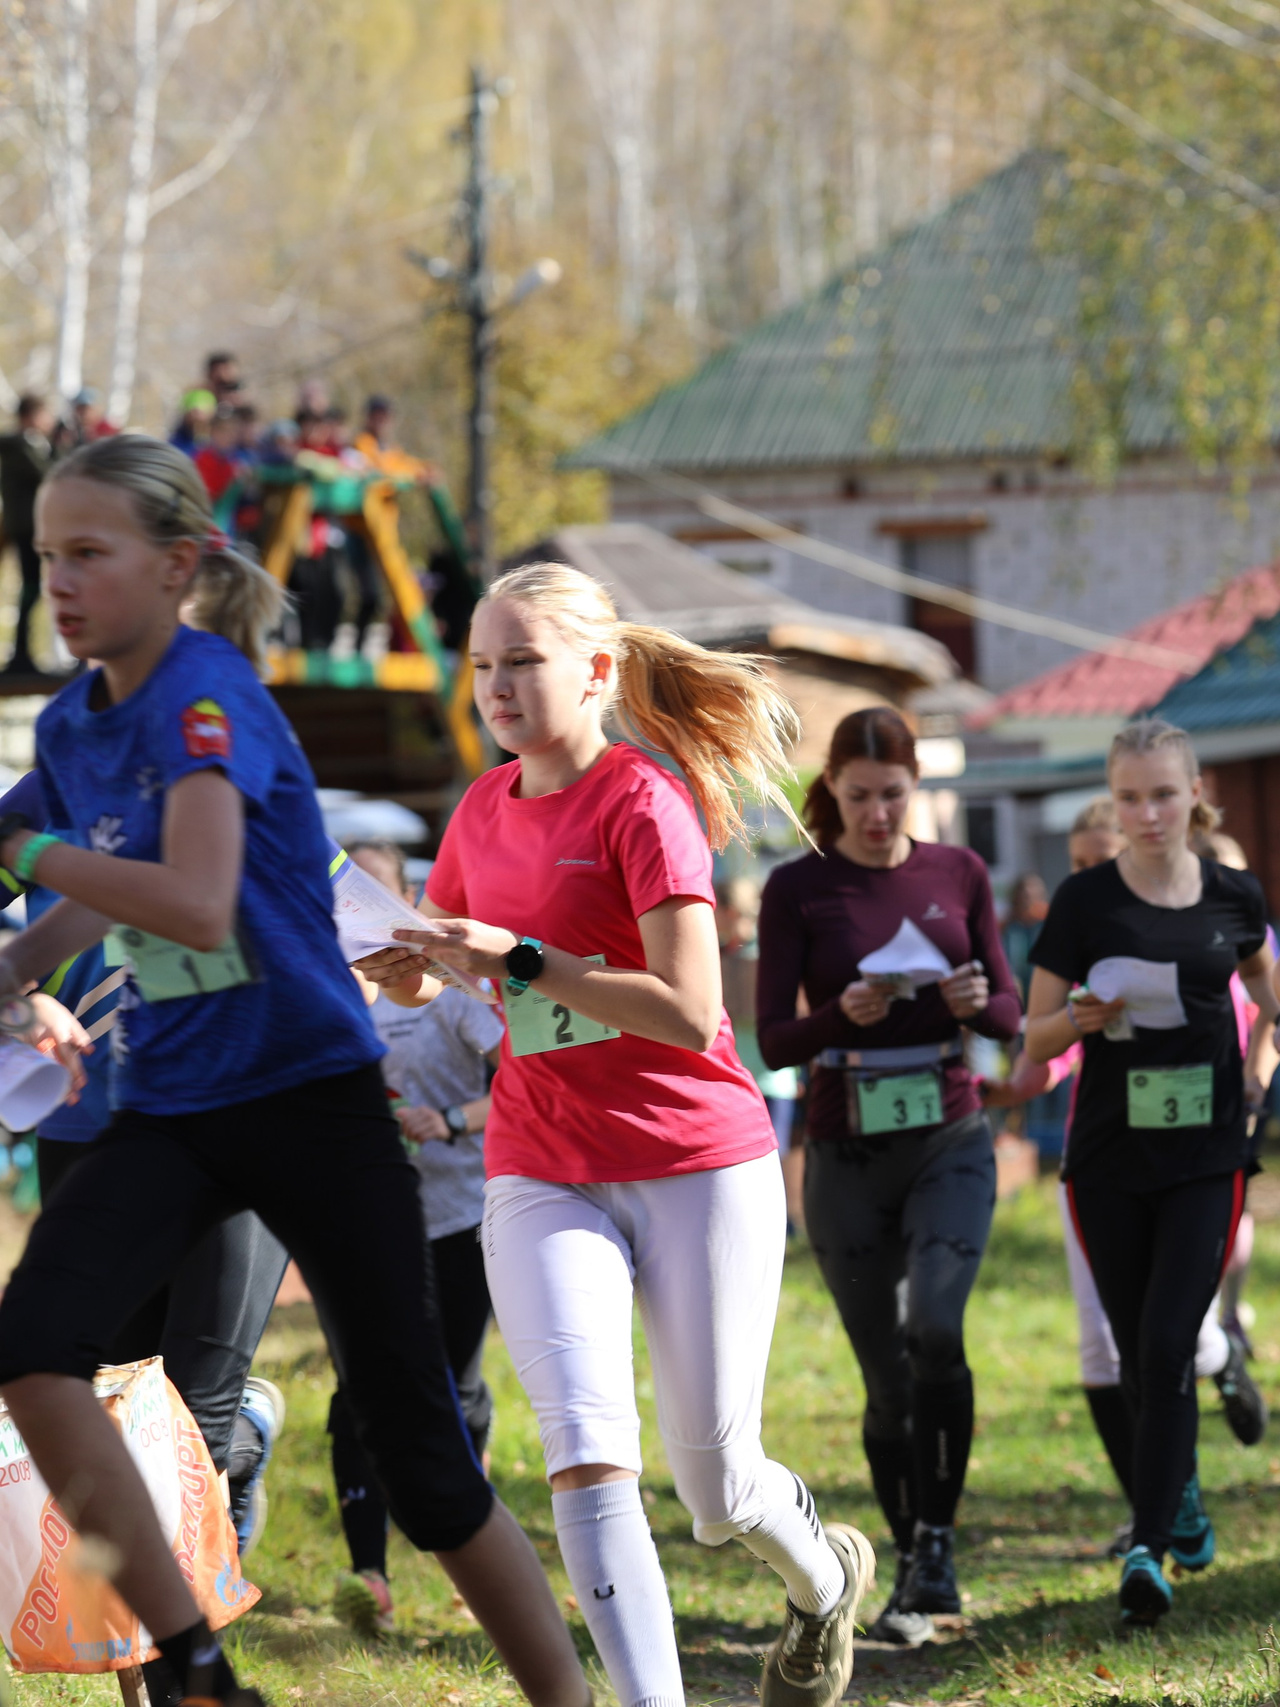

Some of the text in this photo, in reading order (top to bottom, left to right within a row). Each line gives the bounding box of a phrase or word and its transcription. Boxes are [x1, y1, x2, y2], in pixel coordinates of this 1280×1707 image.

[179, 954, 203, 993] 1
[552, 1003, 574, 1045] 2
[893, 1098, 909, 1125] 3
[1163, 1097, 1179, 1124] 3
